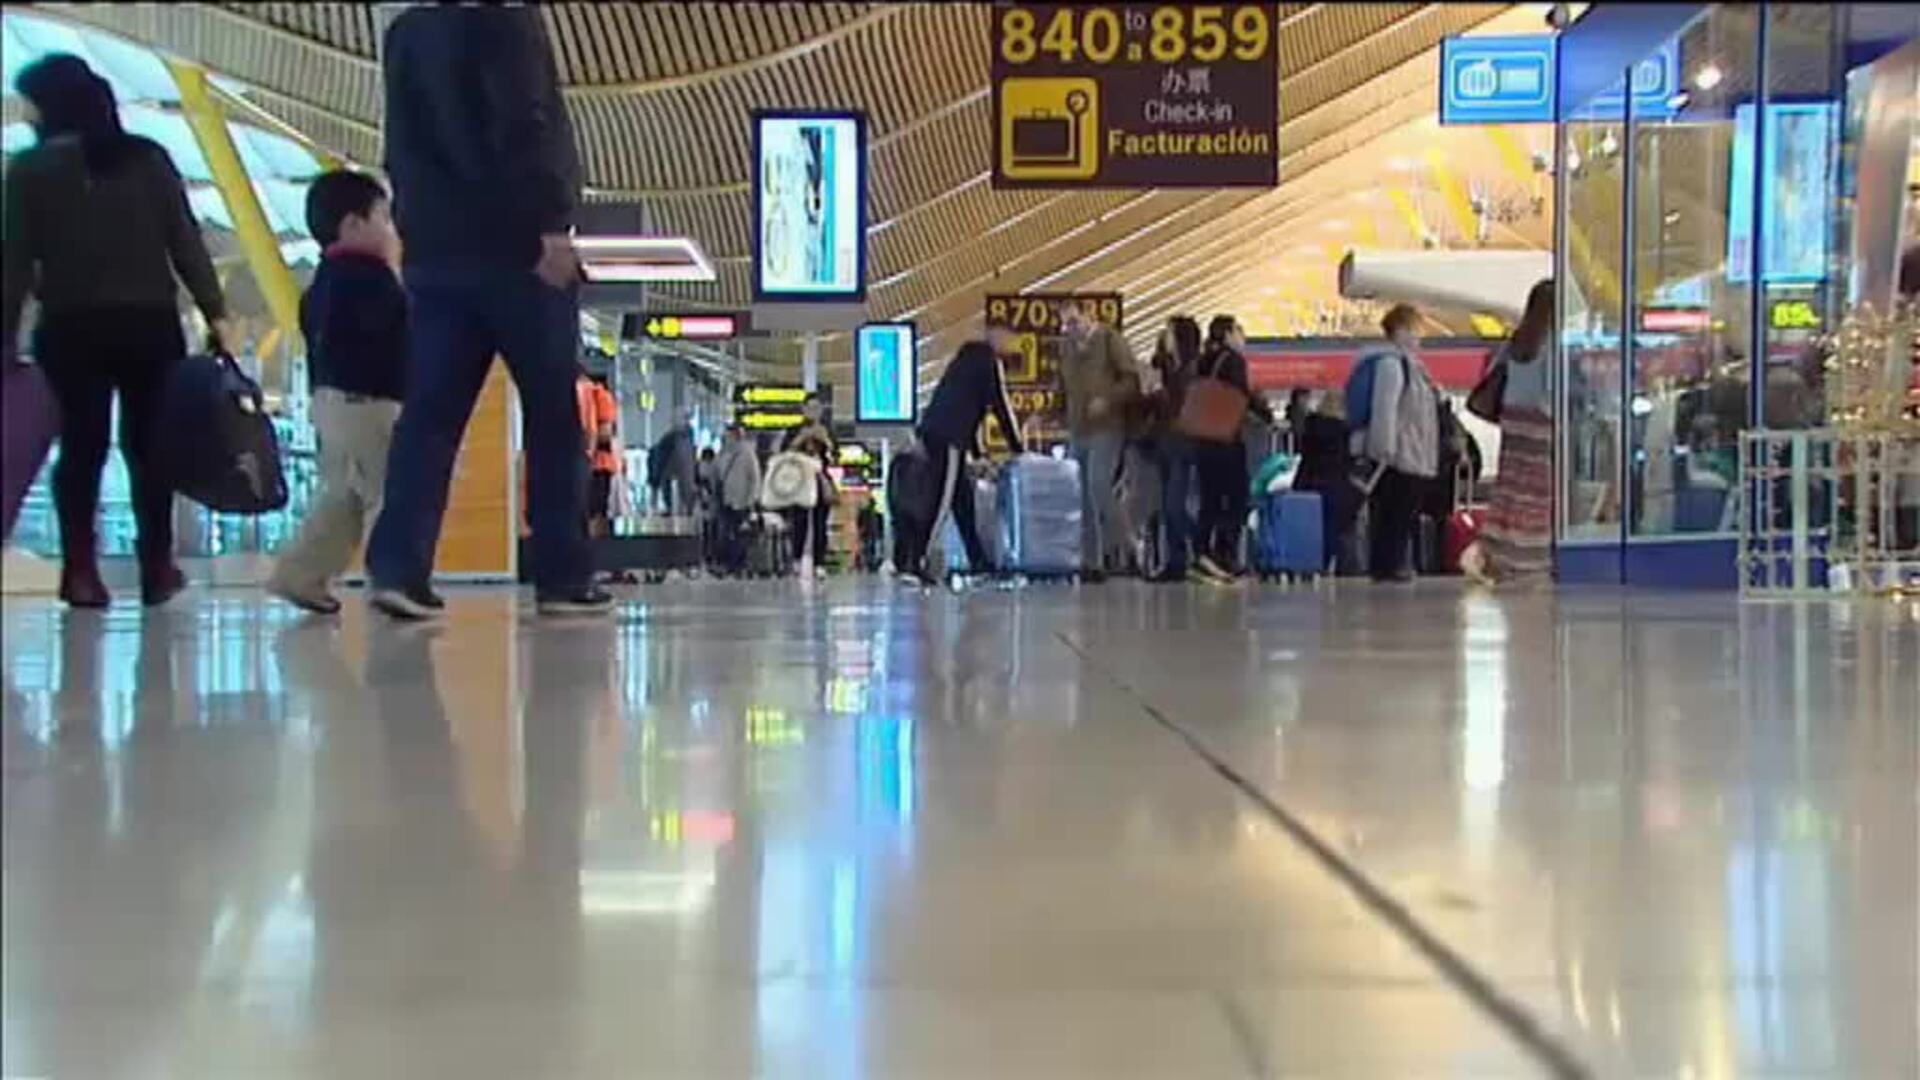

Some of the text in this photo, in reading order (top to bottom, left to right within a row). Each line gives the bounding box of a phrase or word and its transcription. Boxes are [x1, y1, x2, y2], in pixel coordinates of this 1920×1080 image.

[1001, 6, 1269, 63] 840 to 859
[1144, 100, 1233, 123] Check-in
[1108, 129, 1269, 155] Facturación
